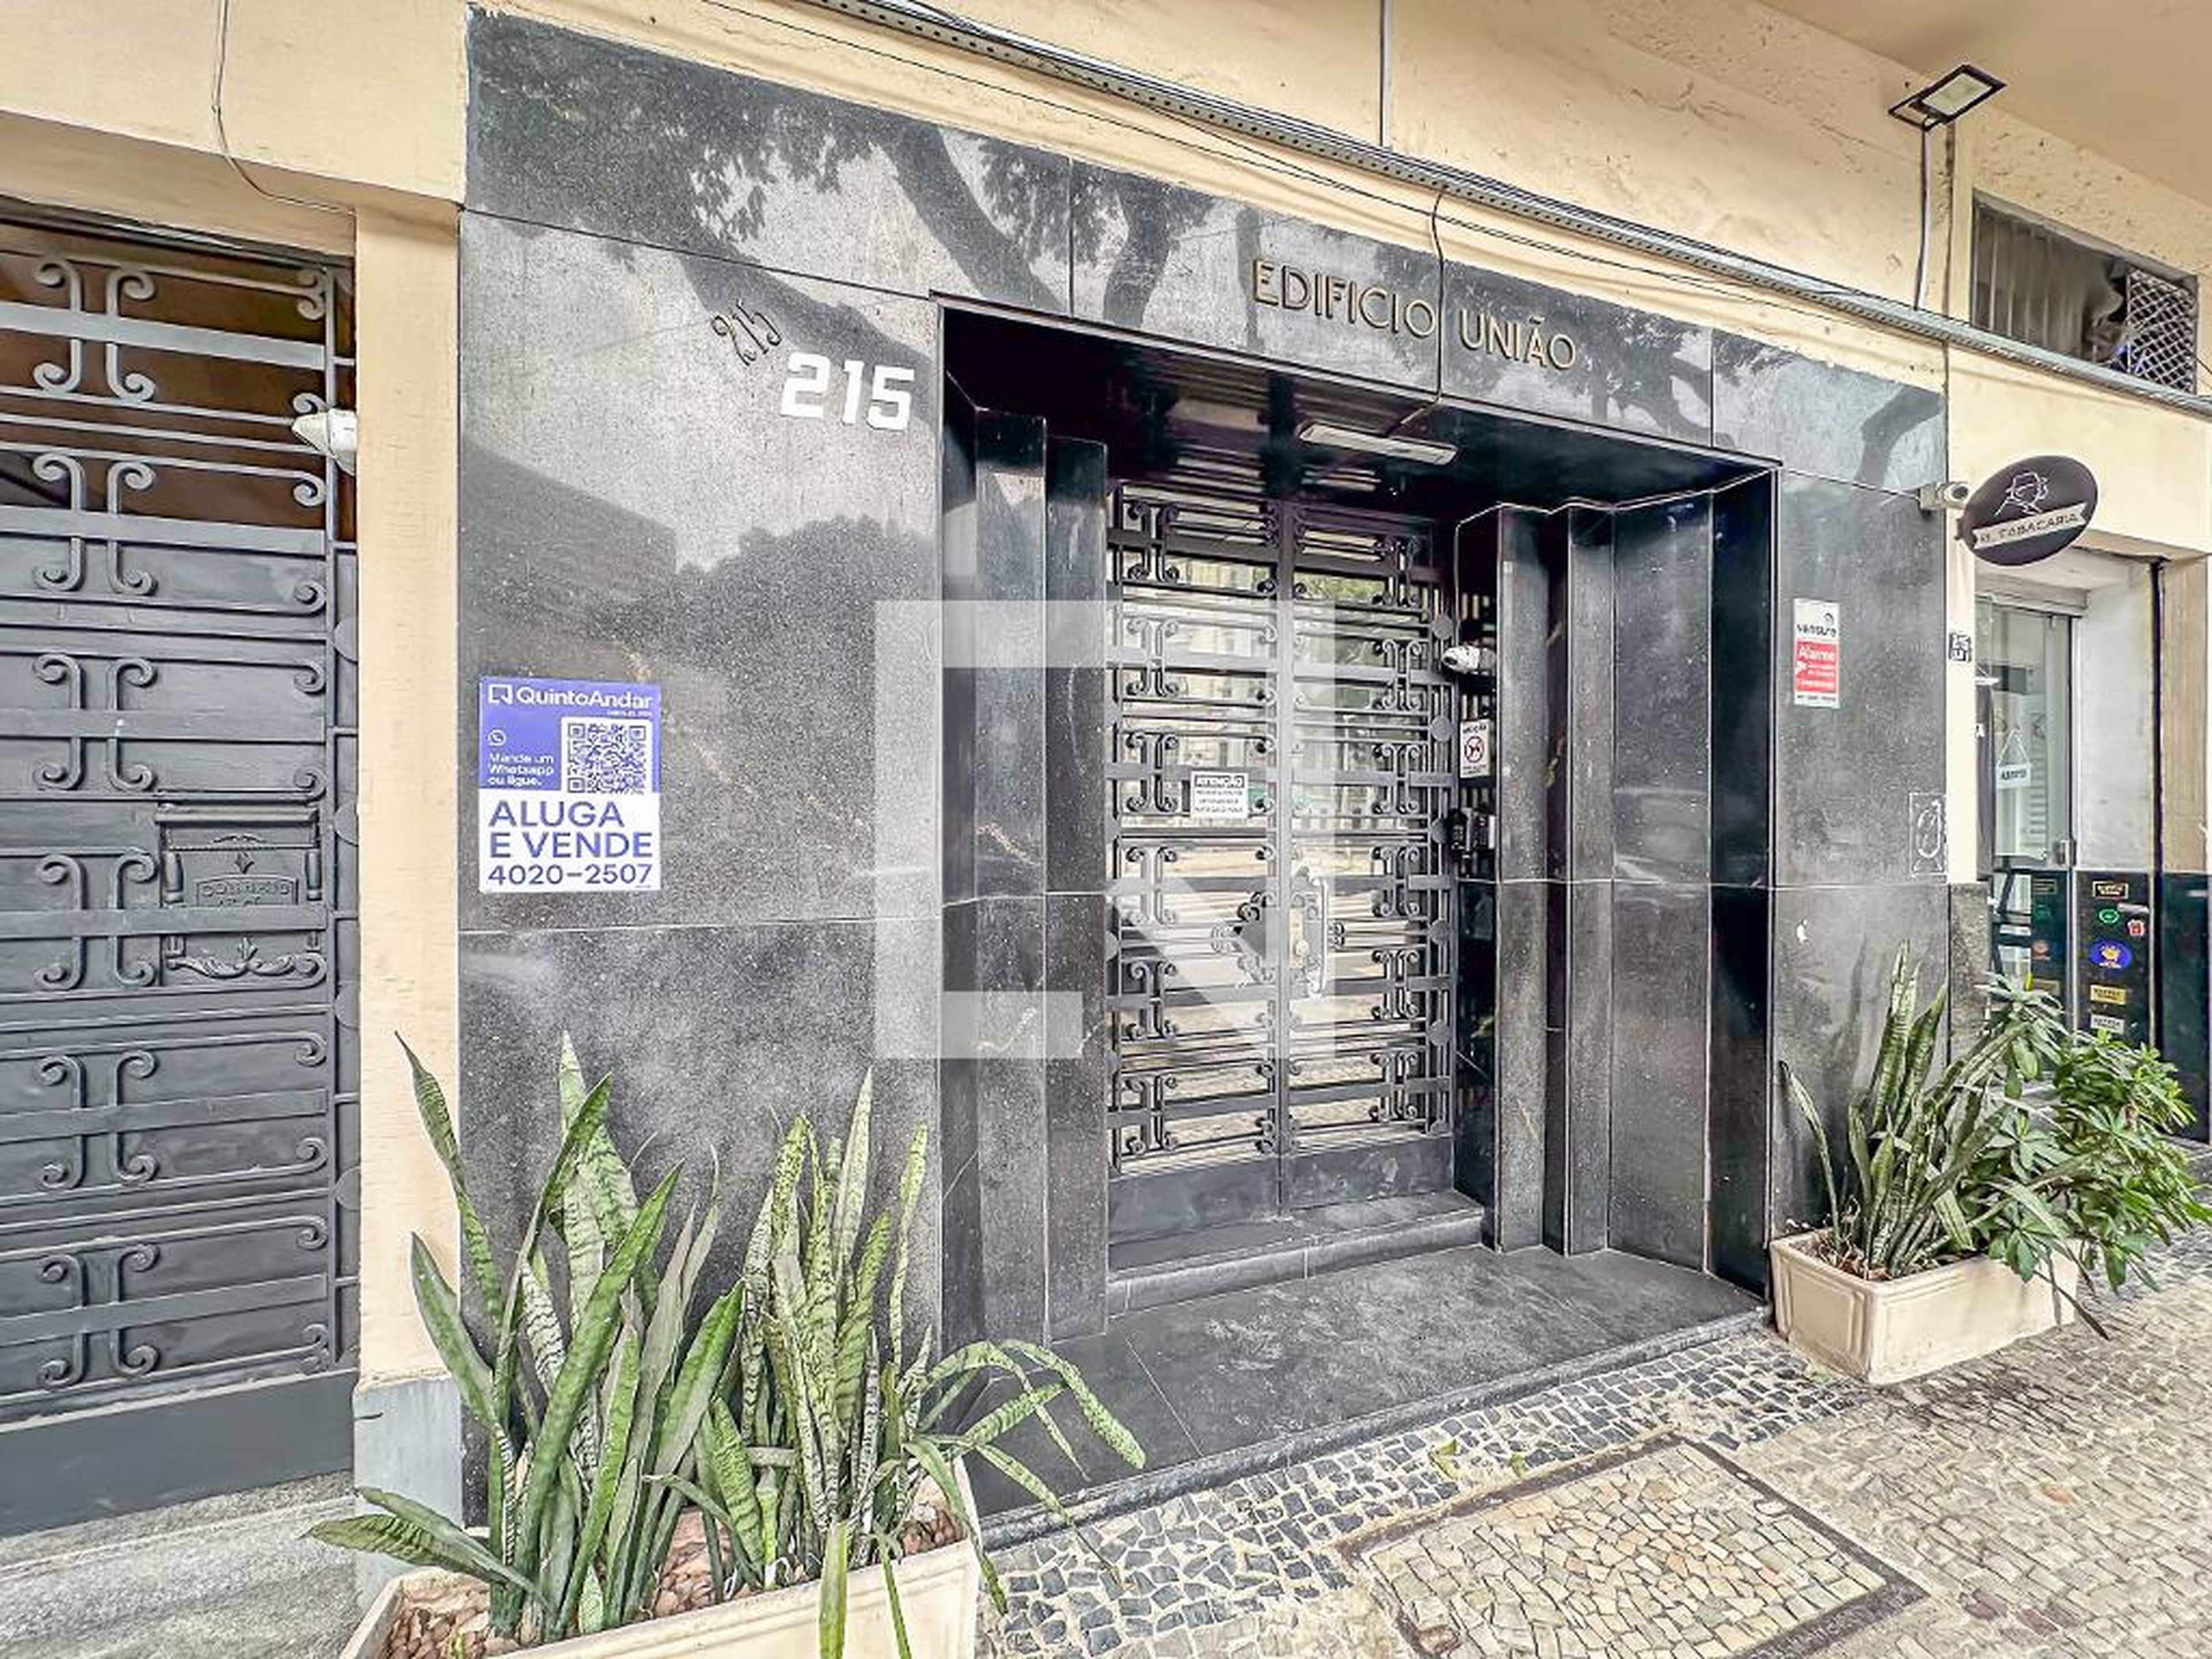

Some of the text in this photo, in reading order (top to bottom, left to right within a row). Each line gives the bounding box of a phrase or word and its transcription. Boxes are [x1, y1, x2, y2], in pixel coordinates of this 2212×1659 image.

[1252, 259, 1577, 370] EDIFICIO UNIÃO
[711, 298, 782, 366] 215
[780, 351, 915, 431] 215
[517, 686, 653, 710] QuintoAndar
[535, 755, 554, 763] um
[488, 801, 625, 828] ALUGA
[490, 832, 653, 858] E VENDE
[488, 863, 653, 885] 4020-2507
